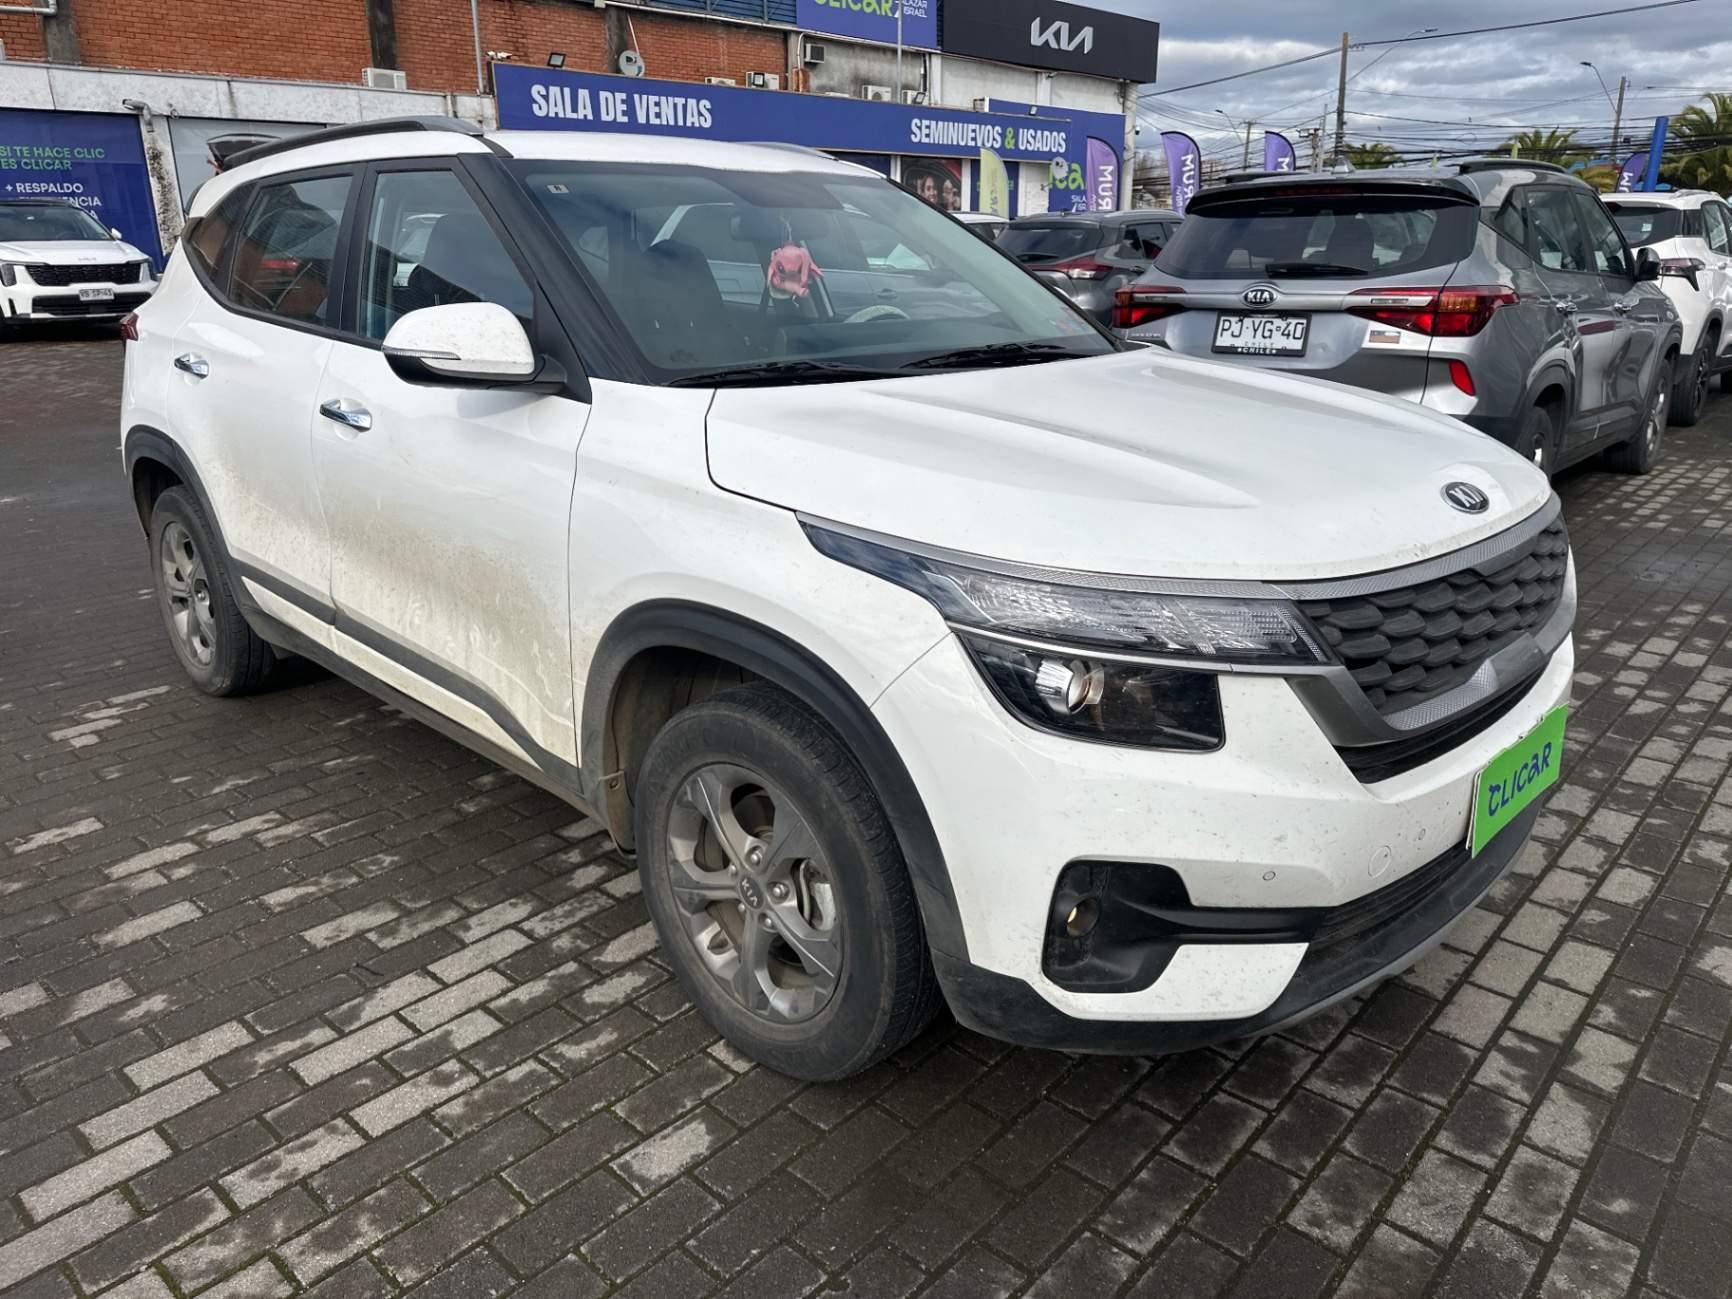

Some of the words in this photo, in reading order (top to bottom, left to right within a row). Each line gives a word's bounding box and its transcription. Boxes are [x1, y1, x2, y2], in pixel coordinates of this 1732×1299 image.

[1031, 16, 1094, 54] KIA
[531, 84, 593, 120] SALA
[599, 90, 629, 123] DE
[633, 94, 712, 128] VENTAS
[911, 118, 1002, 148] SEMINUEVOS
[1004, 127, 1015, 149] &
[1018, 128, 1067, 153] USADOS
[13, 146, 31, 157] TE
[34, 146, 72, 158] HACE
[74, 147, 105, 158] CLIC
[0, 159, 18, 170] ES
[21, 159, 72, 170] CLICAR
[16, 183, 84, 193] RESPALDO
[1247, 291, 1272, 303] KIA
[742, 878, 758, 906] KIA
